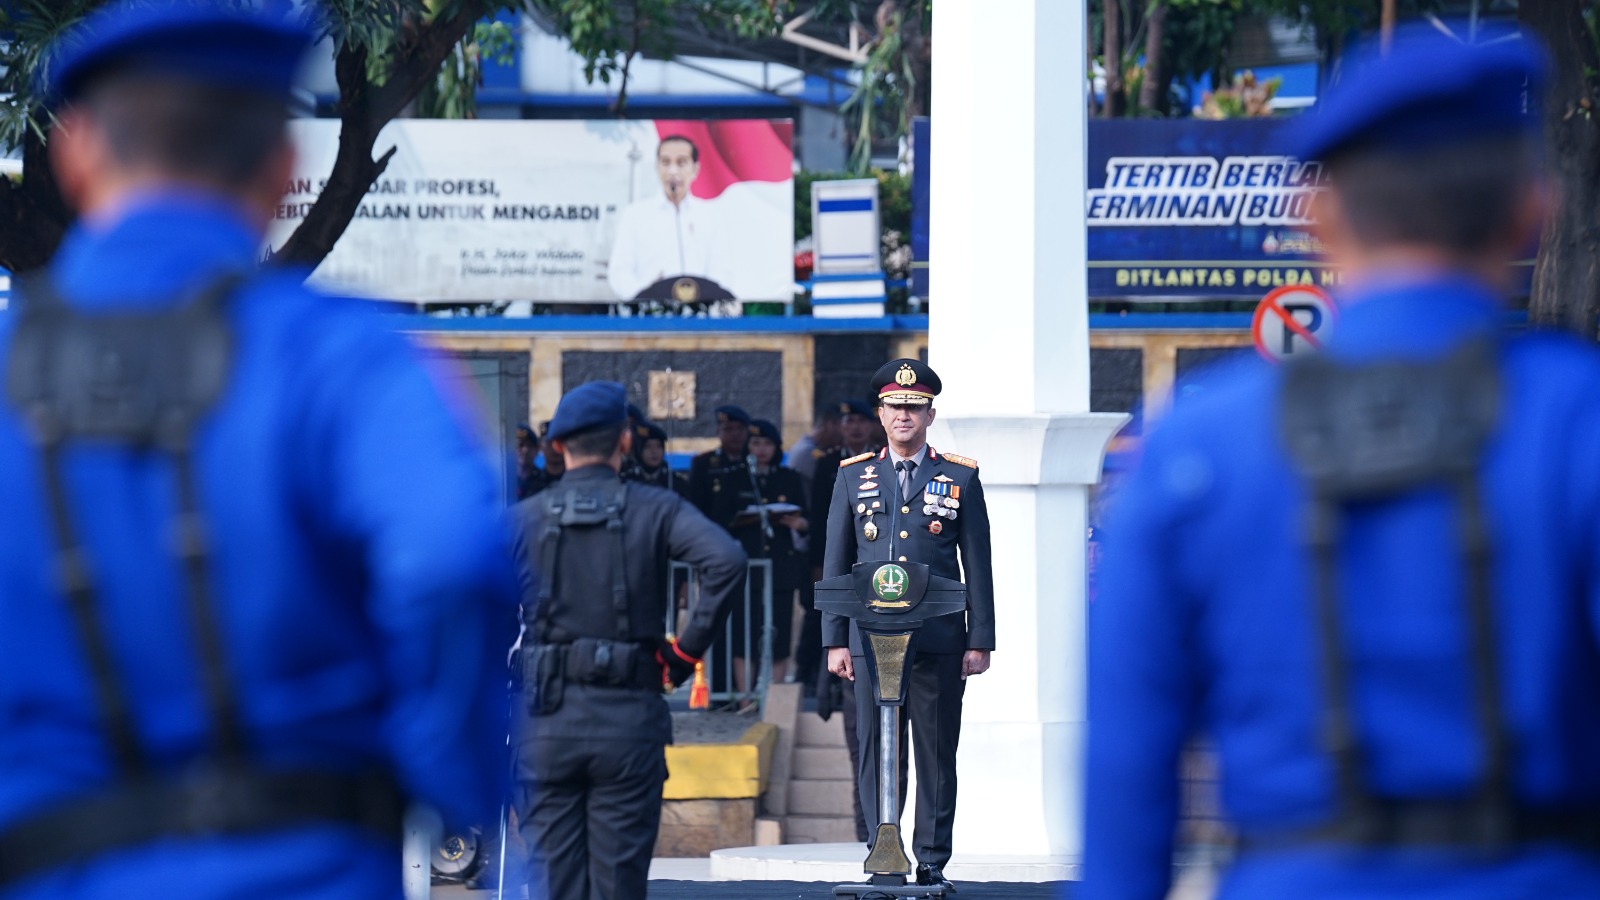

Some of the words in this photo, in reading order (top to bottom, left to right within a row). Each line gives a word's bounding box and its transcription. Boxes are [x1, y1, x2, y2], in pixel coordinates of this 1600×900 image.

[1110, 161, 1215, 188] TERTIB
[414, 180, 500, 197] PROFESI,
[417, 204, 485, 219] UNTUK
[493, 204, 600, 220] MENGABDI
[1086, 193, 1239, 221] ERMINAN
[1245, 193, 1320, 221] BUD
[1115, 268, 1237, 287] DITLANTAS
[1243, 268, 1314, 287] POLDA
